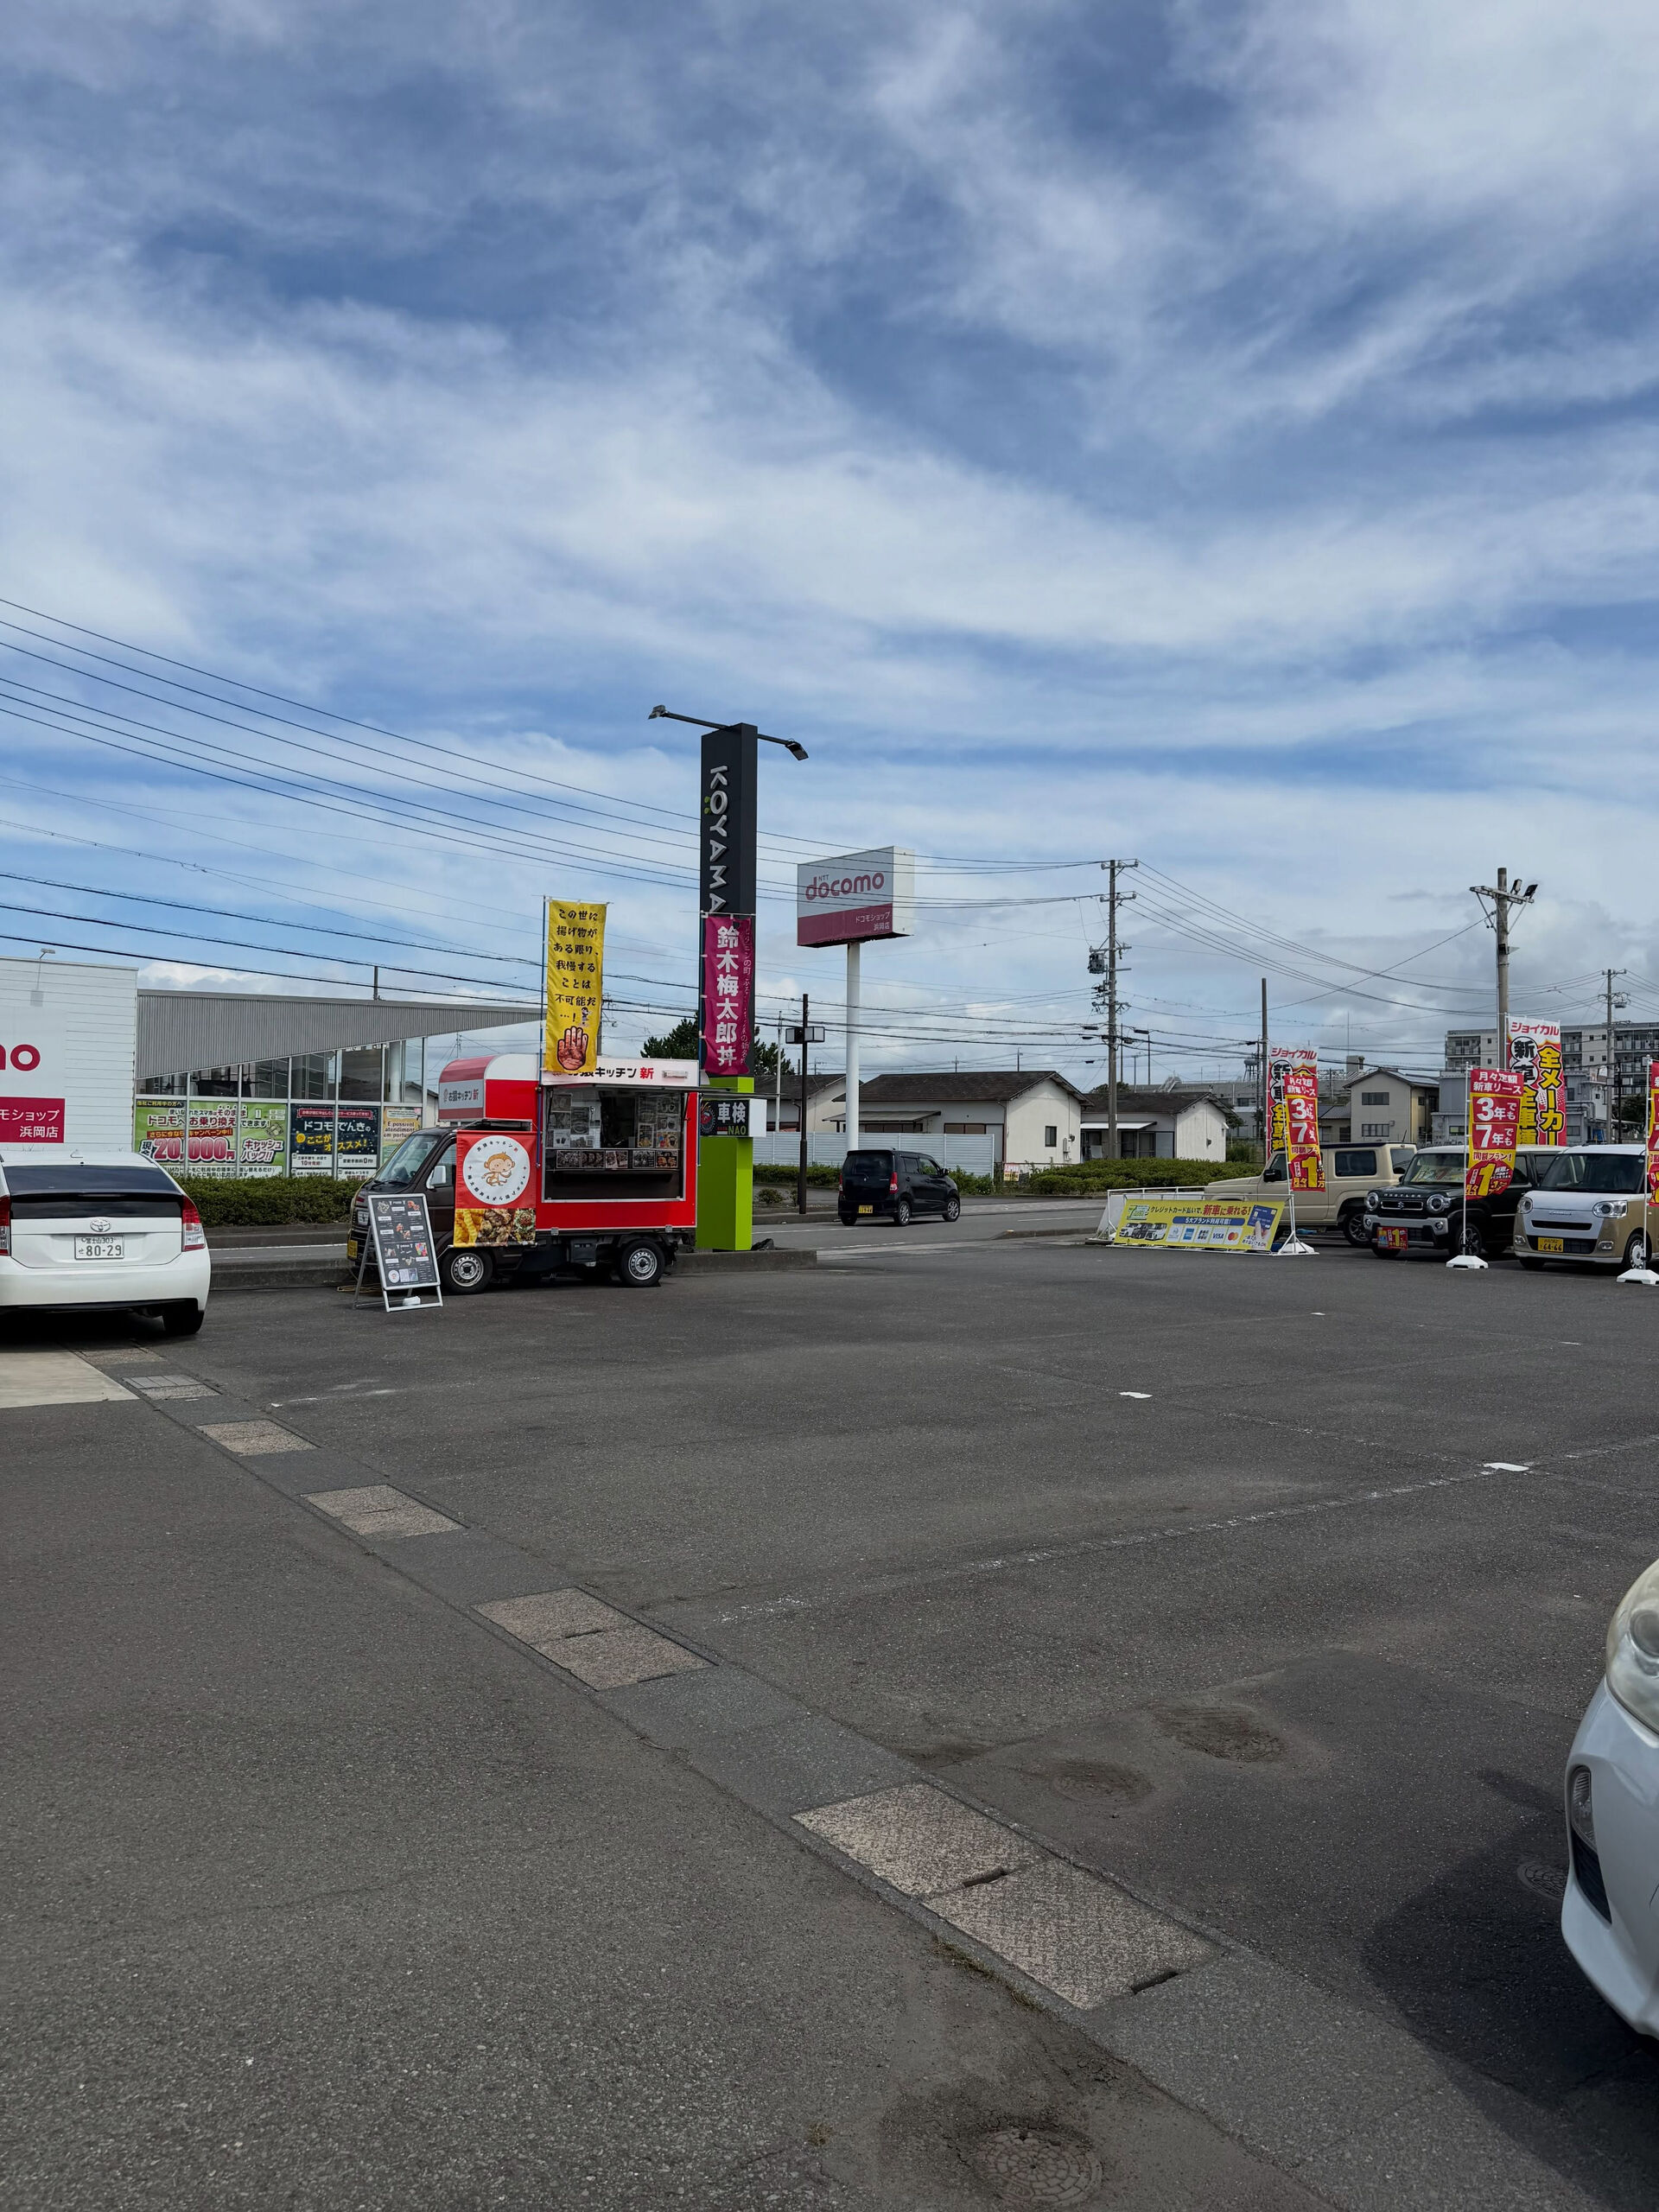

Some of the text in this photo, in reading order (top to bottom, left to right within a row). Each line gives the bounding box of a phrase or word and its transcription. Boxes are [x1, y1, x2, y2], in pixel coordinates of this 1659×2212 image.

[709, 766, 728, 913] KOYAMA
[805, 872, 885, 900] docomo
[558, 908, 599, 920] この世に
[855, 912, 891, 924] ドコモショップ
[556, 925, 597, 938] 揚げ物が
[874, 922, 890, 931] 浜岡店
[553, 943, 599, 956] ある限り、
[556, 960, 595, 973] 我慢する
[562, 978, 591, 989] ことは
[555, 994, 596, 1007] 不可能だ
[716, 925, 740, 1066] 鈴木梅太郎丼
[1510, 1021, 1560, 1036] ジョイカル
[1270, 1047, 1318, 1060] ジョイカル
[1479, 1071, 1518, 1084] 月々定額
[1473, 1082, 1522, 1095] 新車リース
[717, 1102, 746, 1123] 車検
[20, 1126, 59, 1138] 浜岡店
[728, 1125, 747, 1135] NAO
[86, 1244, 122, 1256] 80-29
